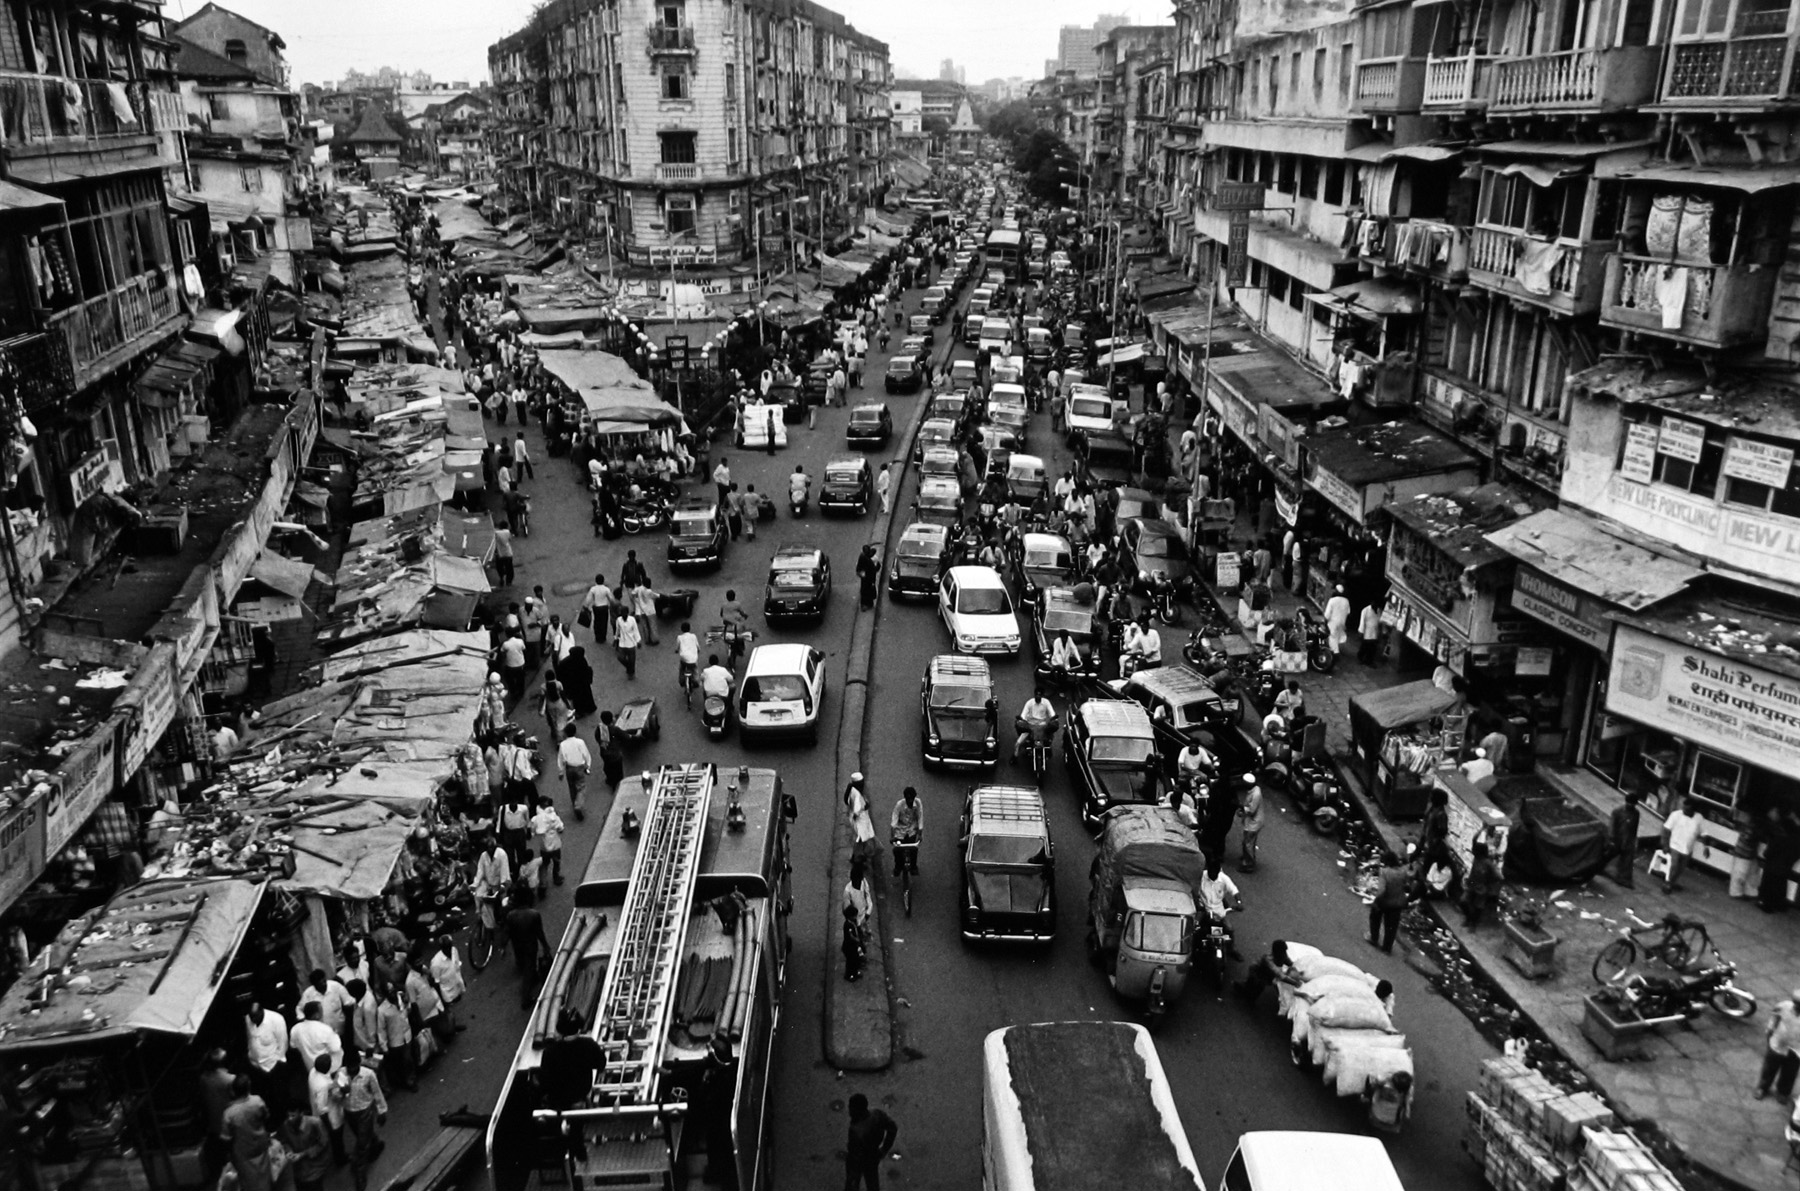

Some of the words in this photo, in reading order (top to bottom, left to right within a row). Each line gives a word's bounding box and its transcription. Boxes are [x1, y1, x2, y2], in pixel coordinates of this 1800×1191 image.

[1636, 485, 1657, 510] LIFE
[1659, 496, 1719, 532] POLYCLINIC
[1730, 519, 1781, 548] NEW
[1520, 571, 1578, 612] THOMSON
[1558, 615, 1598, 641] CONCEPT
[1681, 655, 1735, 685] Shahi
[1690, 681, 1730, 705] शाही
[1691, 702, 1738, 727] ENTERPRISES
